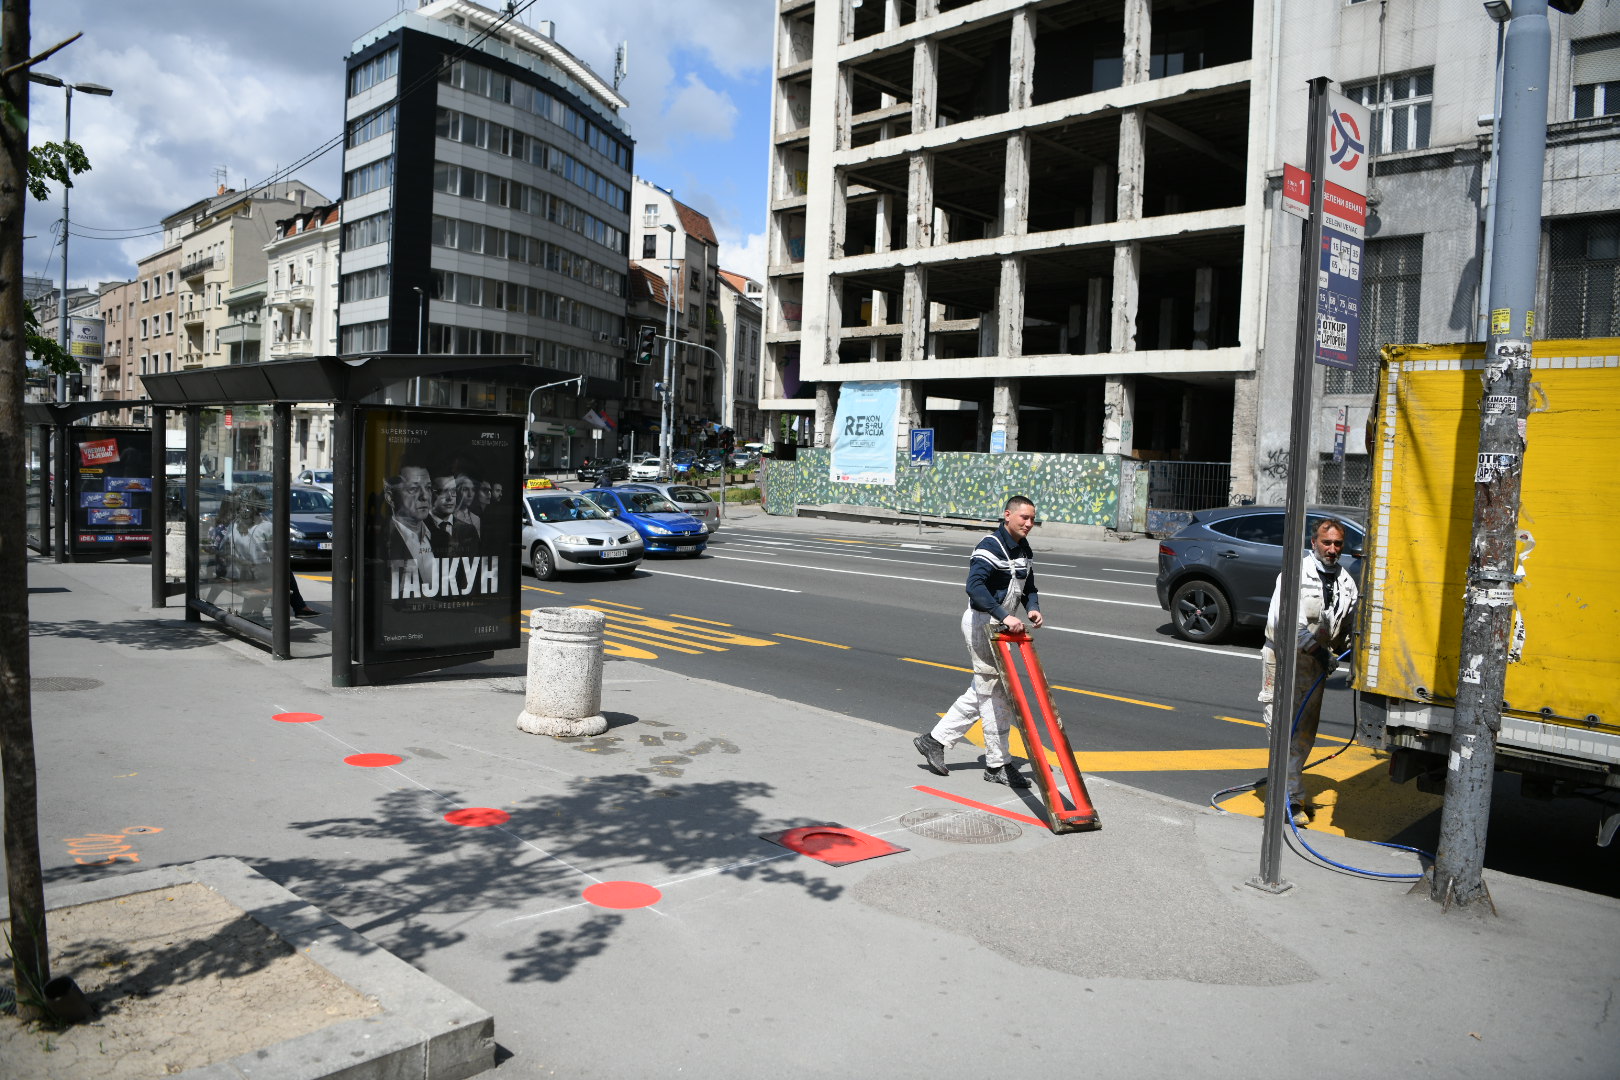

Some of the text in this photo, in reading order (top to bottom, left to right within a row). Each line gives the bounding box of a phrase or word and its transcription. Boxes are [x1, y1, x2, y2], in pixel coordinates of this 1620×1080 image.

[1300, 180, 1305, 196] 1
[1323, 192, 1363, 215] ЗЕЛЕНИ ВЕНАЦ
[1325, 216, 1358, 235] ZELENI VENAC
[1333, 242, 1338, 251] 15
[1320, 293, 1326, 302] 15
[1339, 299, 1346, 308] 75
[1322, 320, 1346, 333] OTKUP
[1321, 333, 1346, 347] LAPTOPOVA
[844, 415, 866, 436] RE
[388, 555, 499, 600] ТАЈКУН
